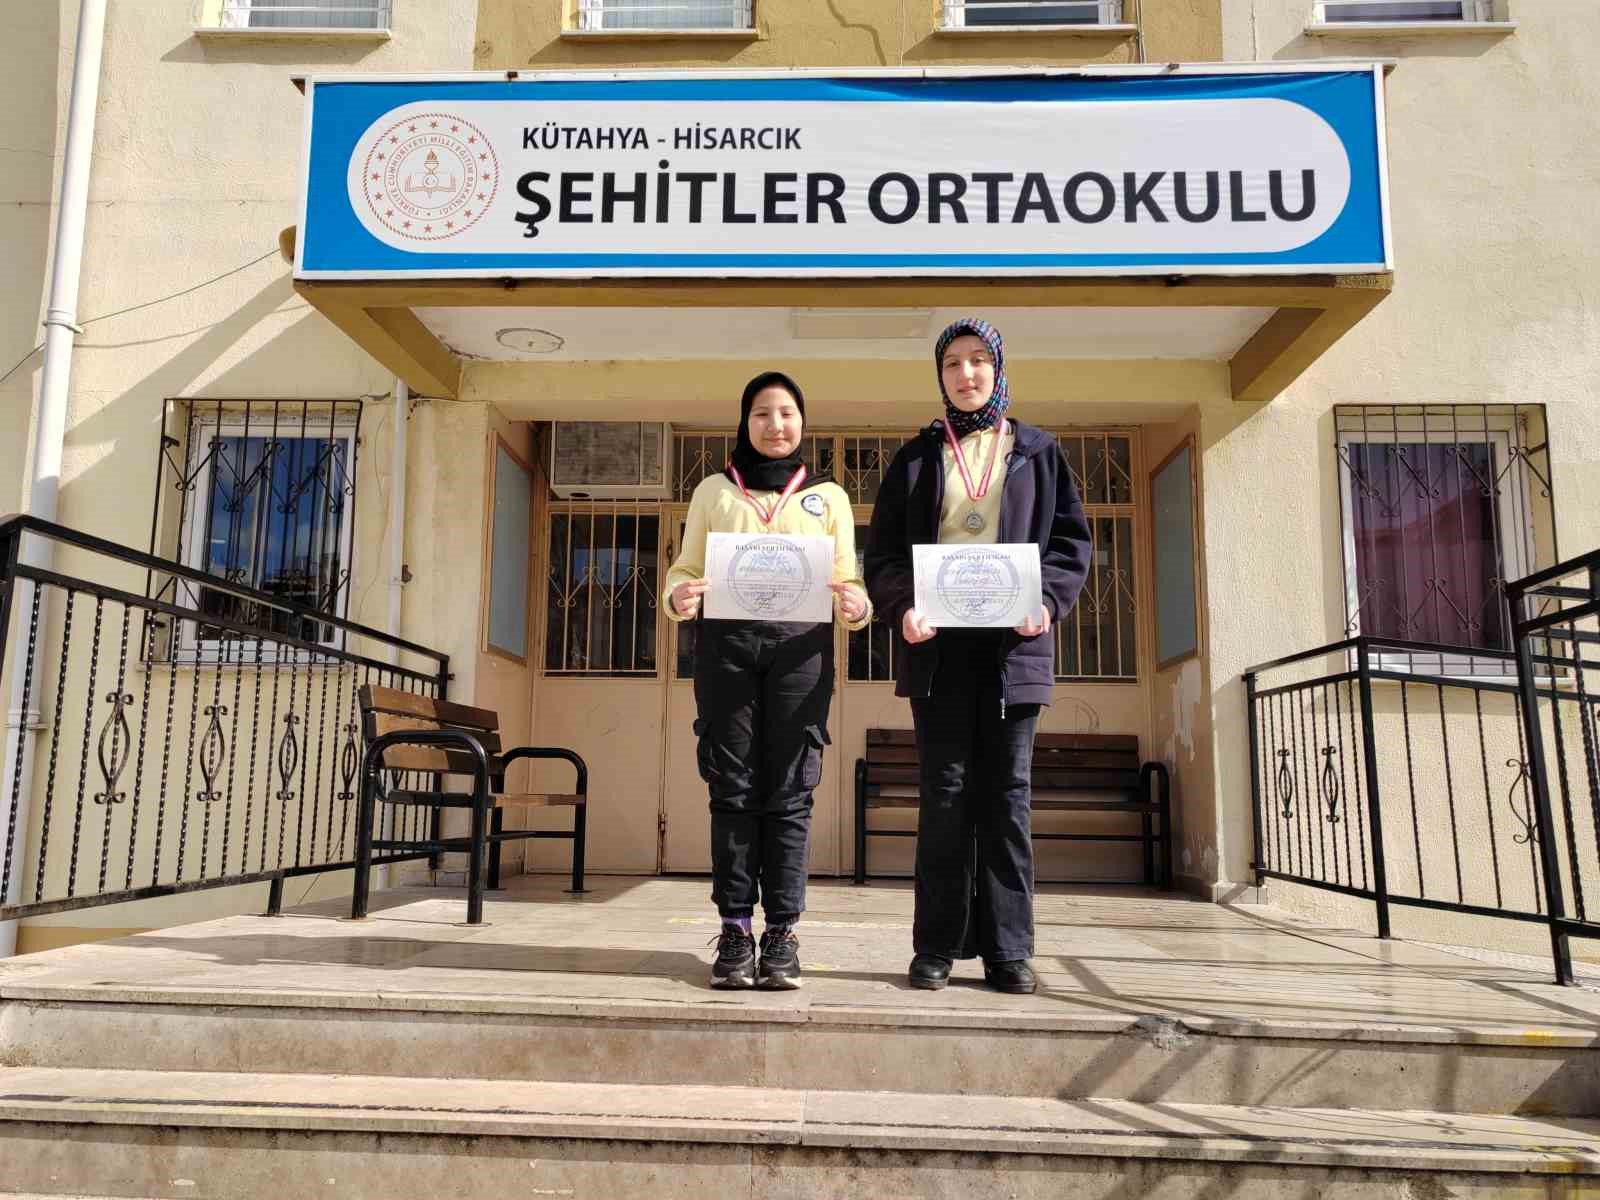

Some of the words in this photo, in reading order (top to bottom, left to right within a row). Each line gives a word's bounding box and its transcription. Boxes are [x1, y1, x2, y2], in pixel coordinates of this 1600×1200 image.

[523, 121, 650, 150] KÜTAHYA
[674, 121, 801, 151] HİSARCIK
[514, 159, 847, 239] ŞEHİTLER
[867, 169, 1316, 225] ORTAOKULU
